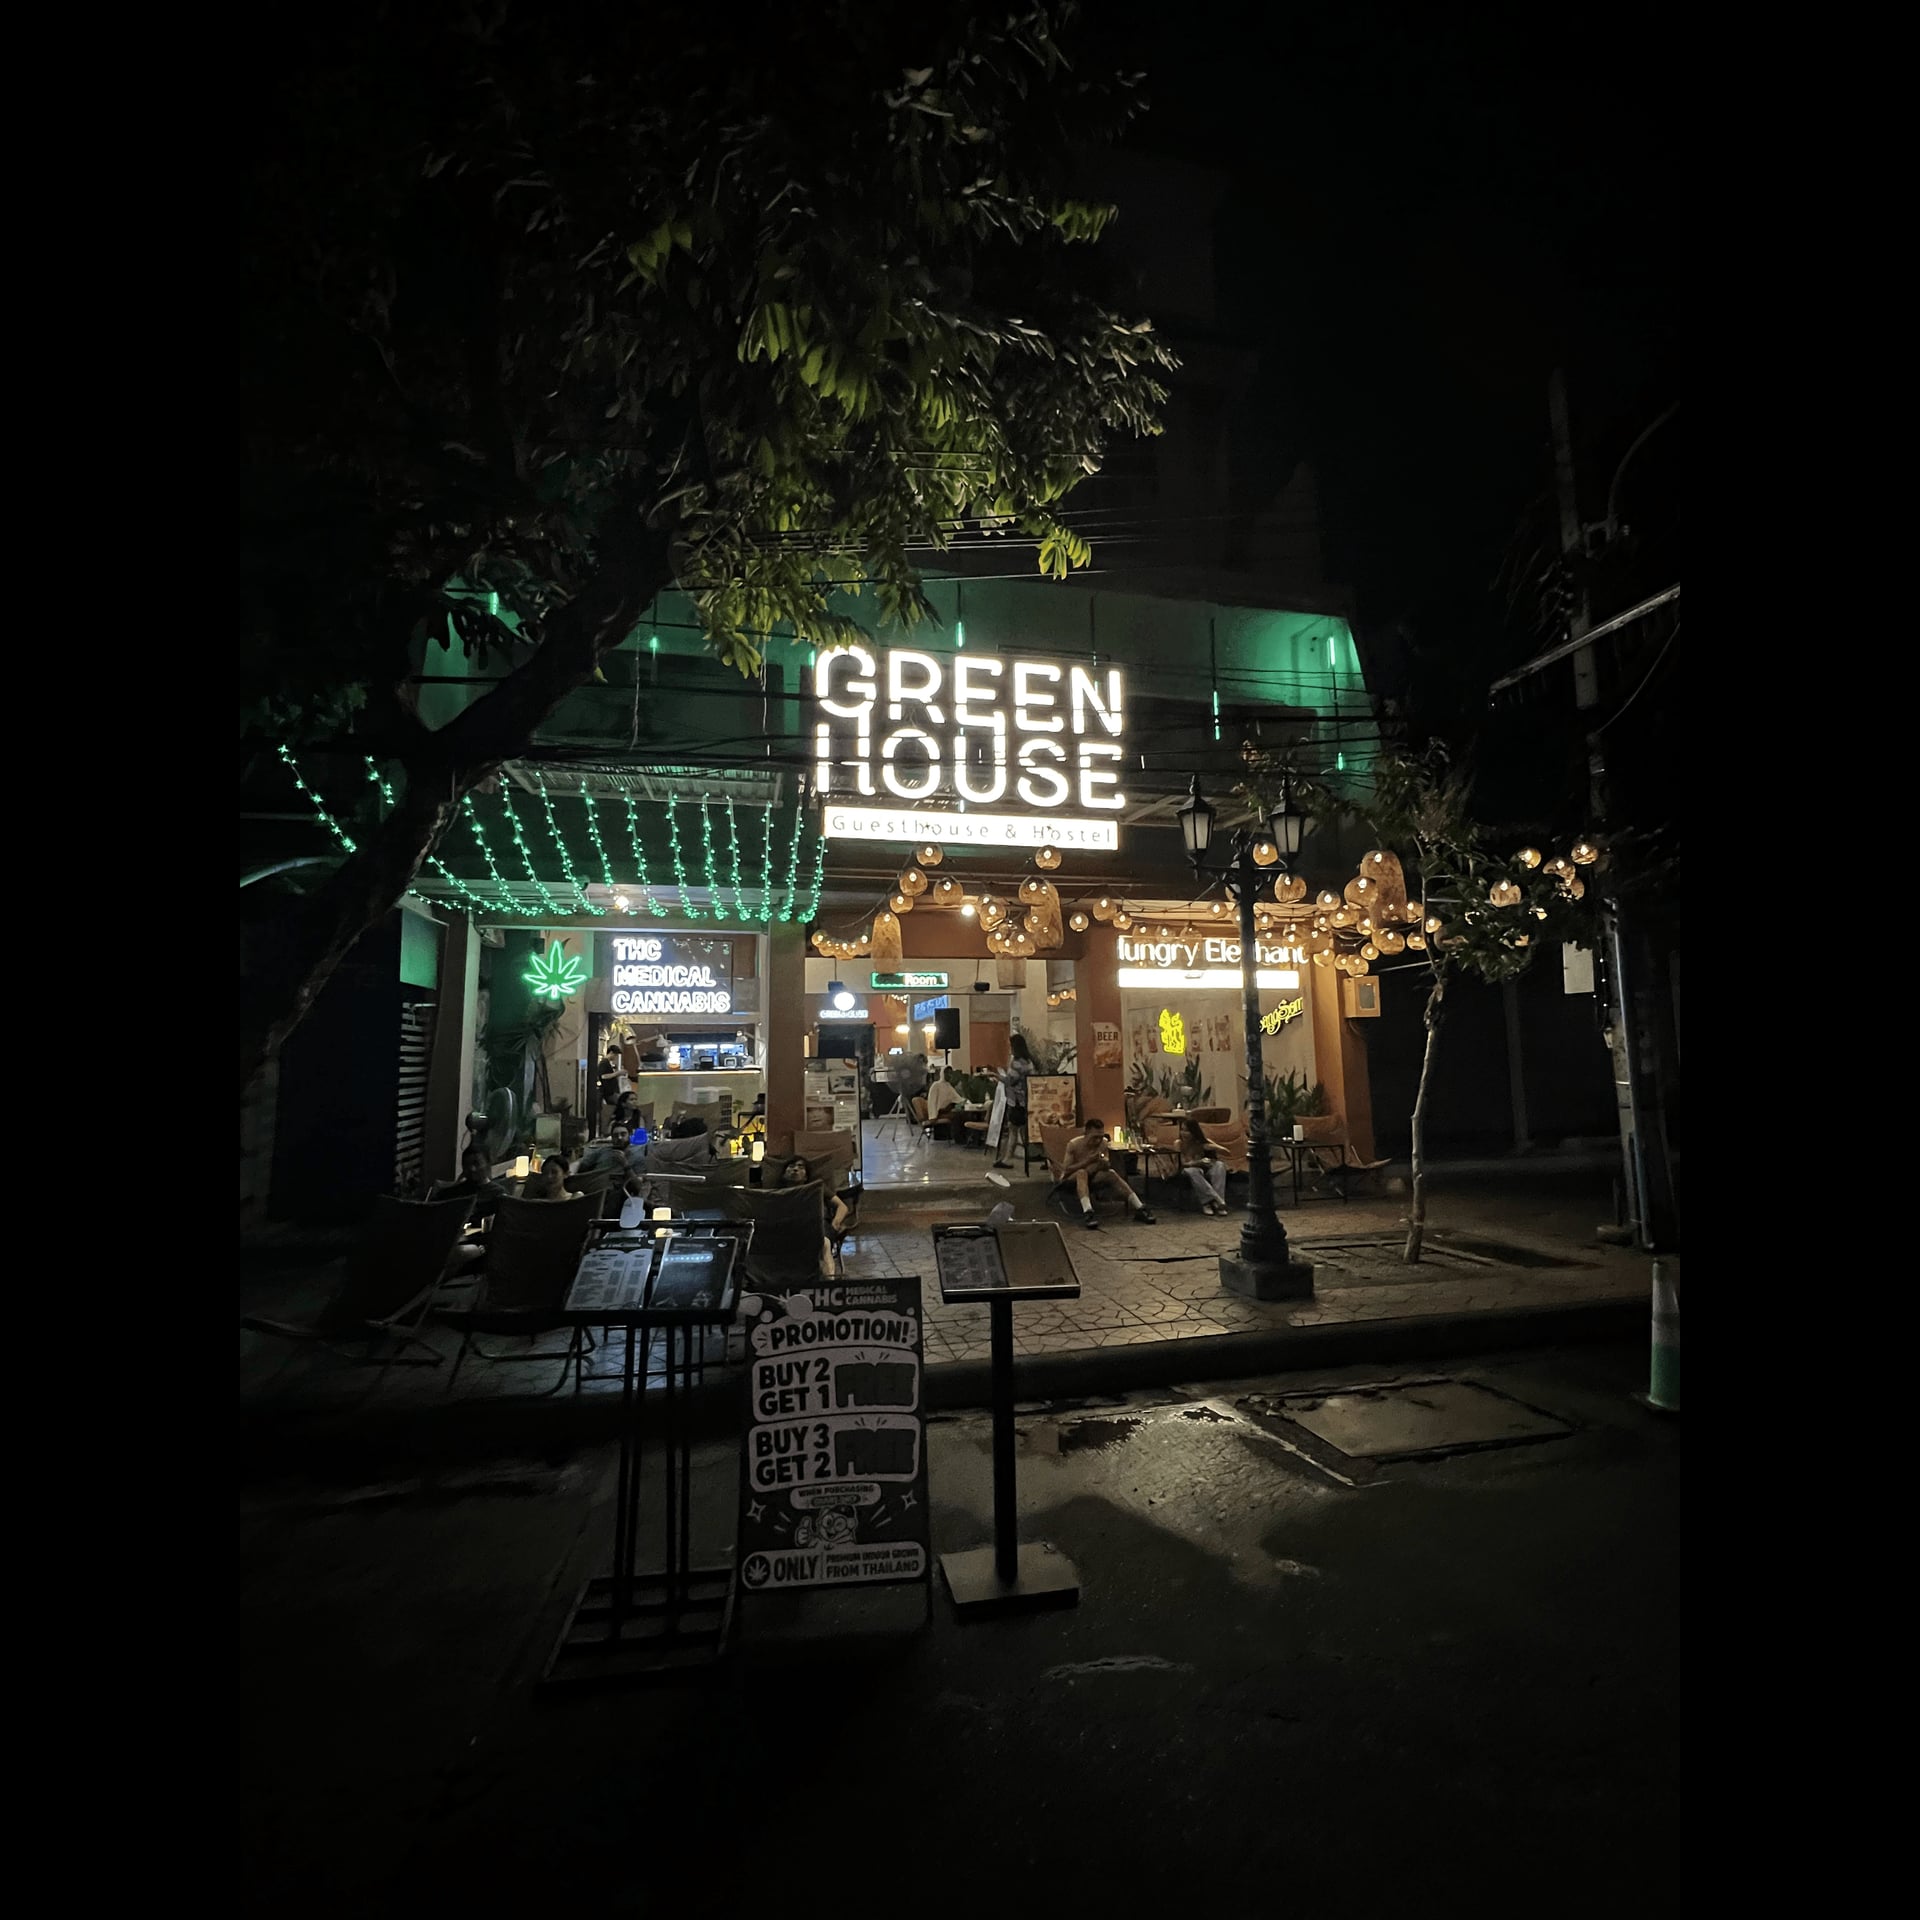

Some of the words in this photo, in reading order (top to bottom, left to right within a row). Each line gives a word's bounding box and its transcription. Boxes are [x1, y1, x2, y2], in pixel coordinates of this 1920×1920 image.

[815, 645, 1123, 737] GREEN
[815, 722, 1126, 810] HOUSE
[832, 815, 990, 839] Guesthouse
[1004, 824, 1018, 838] &
[1032, 826, 1112, 844] Hostel
[613, 938, 662, 961] THC
[1204, 938, 1309, 965] Elehant
[613, 965, 717, 987] MEDICAL
[612, 990, 731, 1013] CANNABIS
[1097, 1031, 1119, 1041] BEER
[845, 1286, 888, 1296] MEDICAL
[845, 1294, 898, 1306] CANNABIS
[770, 1318, 910, 1350] PROMOTION!
[759, 1360, 811, 1389] BUY
[815, 1358, 830, 1382] 2
[759, 1386, 810, 1416] GET
[817, 1385, 830, 1409] 1
[756, 1426, 809, 1457] BUY
[813, 1423, 830, 1449] 3
[756, 1453, 808, 1485] GET
[814, 1452, 831, 1478] 2
[774, 1555, 818, 1581] ONLY
[826, 1564, 859, 1578] FROM
[863, 1560, 920, 1576] THAILAND
